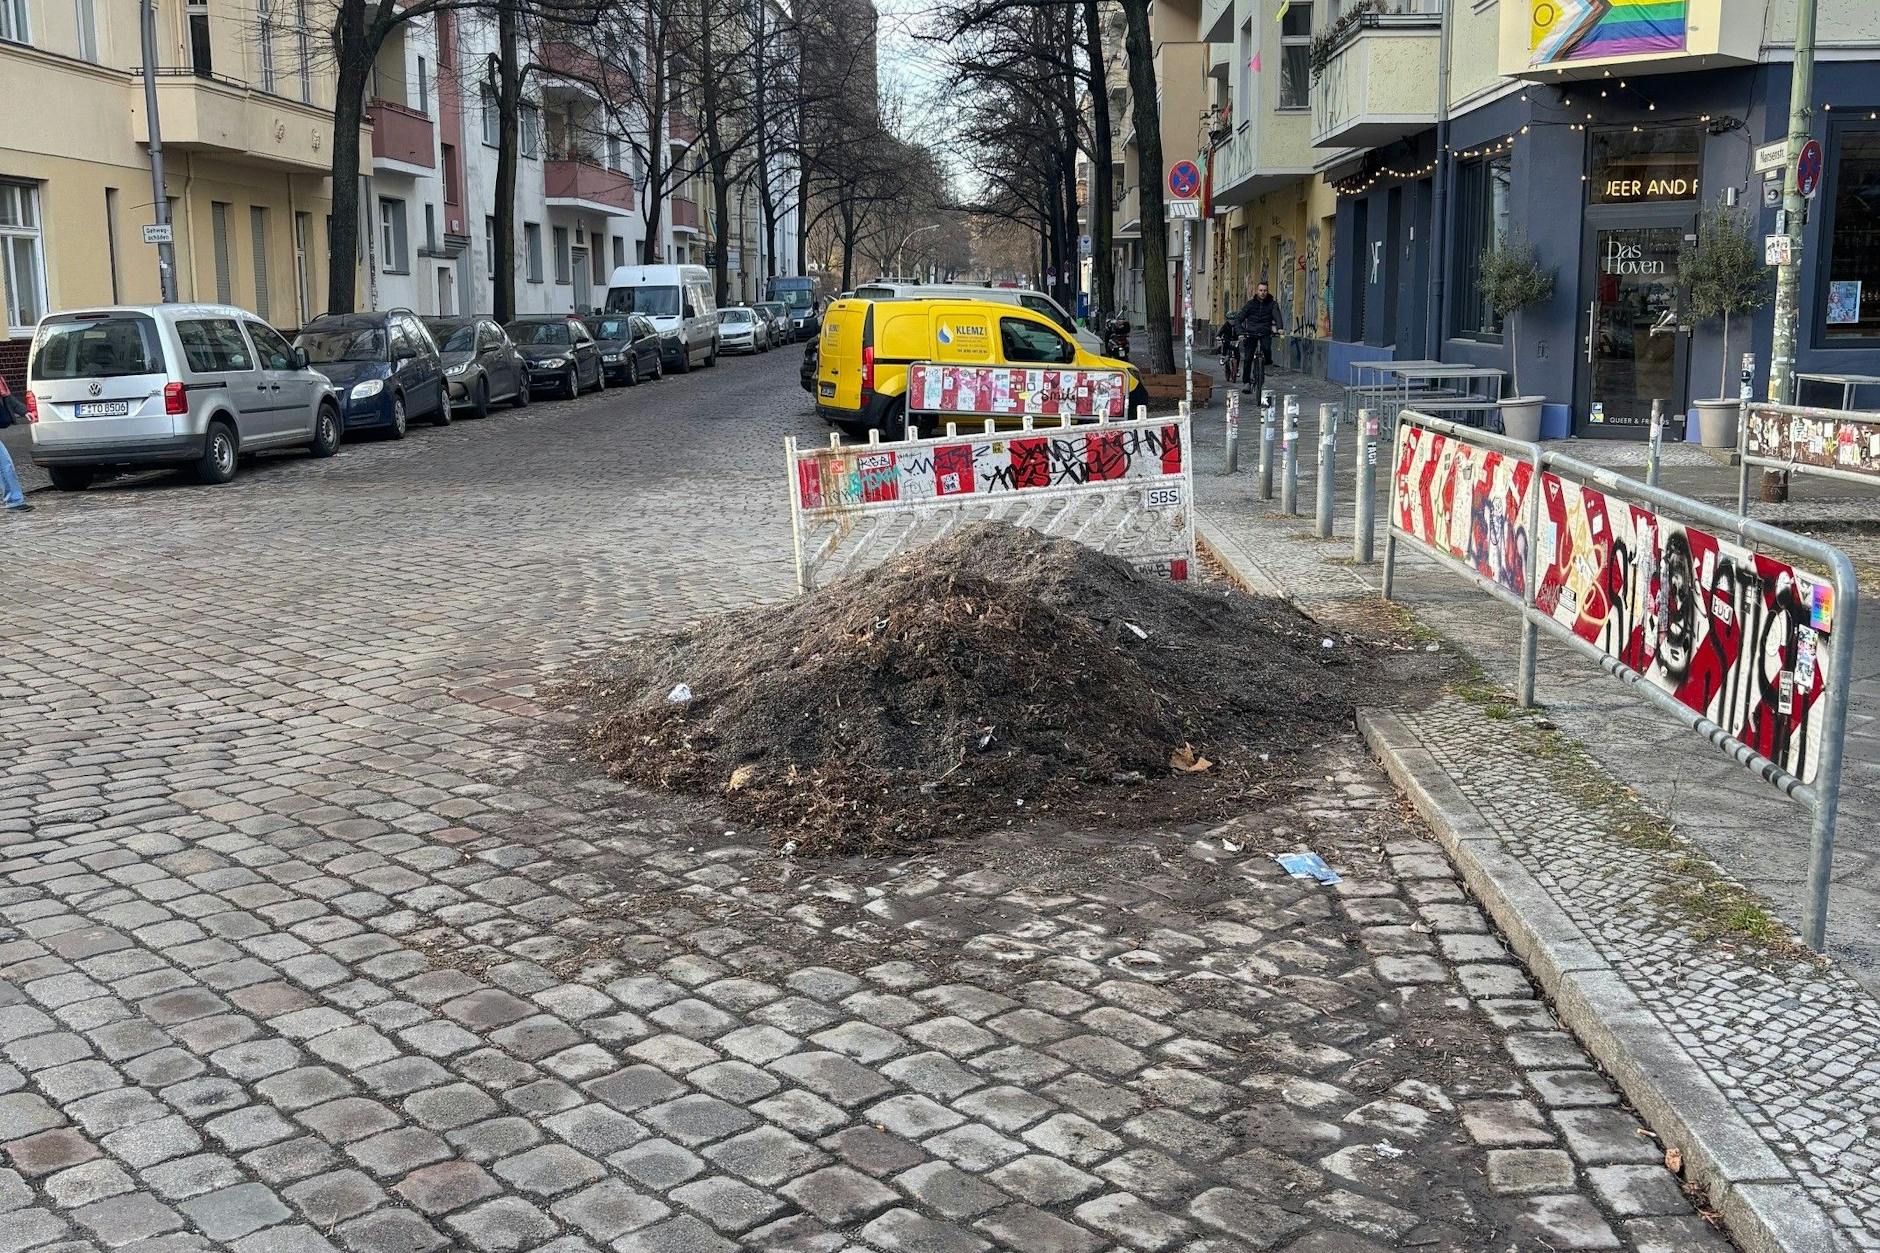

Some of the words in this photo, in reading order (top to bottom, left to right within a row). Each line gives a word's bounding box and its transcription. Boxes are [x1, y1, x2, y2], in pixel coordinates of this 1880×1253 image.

[1646, 179, 1687, 195] AND
[1607, 236, 1641, 259] Das
[1606, 257, 1665, 275] Hoven
[104, 403, 126, 413] 8506
[1609, 416, 1633, 425] QUEER
[1150, 490, 1178, 504] SBS
